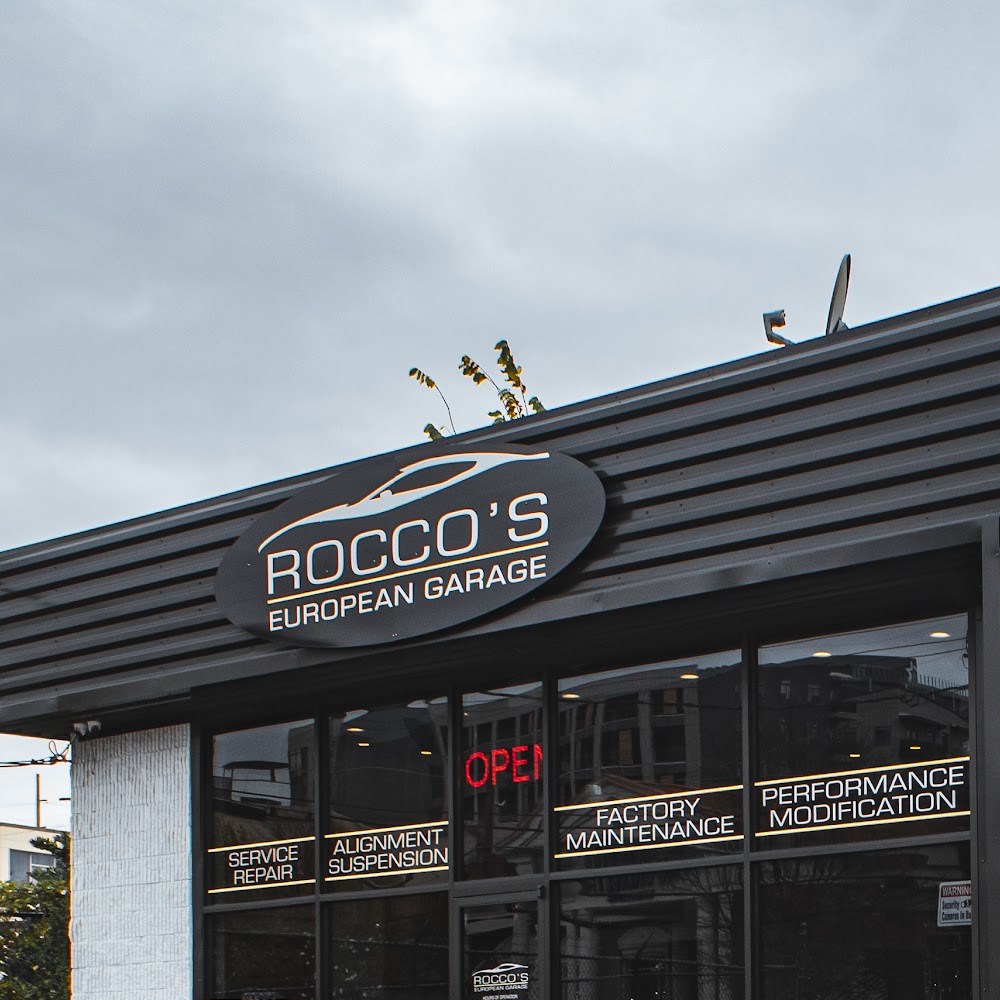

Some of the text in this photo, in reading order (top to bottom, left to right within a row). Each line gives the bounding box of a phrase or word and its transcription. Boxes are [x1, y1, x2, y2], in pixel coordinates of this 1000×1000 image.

[267, 492, 549, 595] ROCCO'S
[268, 555, 547, 632] EUROPEAN GARAGE
[761, 765, 965, 807] PERFORMANCE
[596, 797, 701, 827] FACTORY
[769, 790, 957, 828] MODIFICATION
[333, 829, 443, 856] ALIGNMENT
[566, 815, 735, 851] MAINTENANCE
[228, 845, 299, 868] SERVICE
[328, 848, 449, 874] SUSPENSION
[233, 864, 293, 885] REPAIR
[942, 885, 971, 896] WARNIN
[473, 972, 529, 985] ROCCO'S
